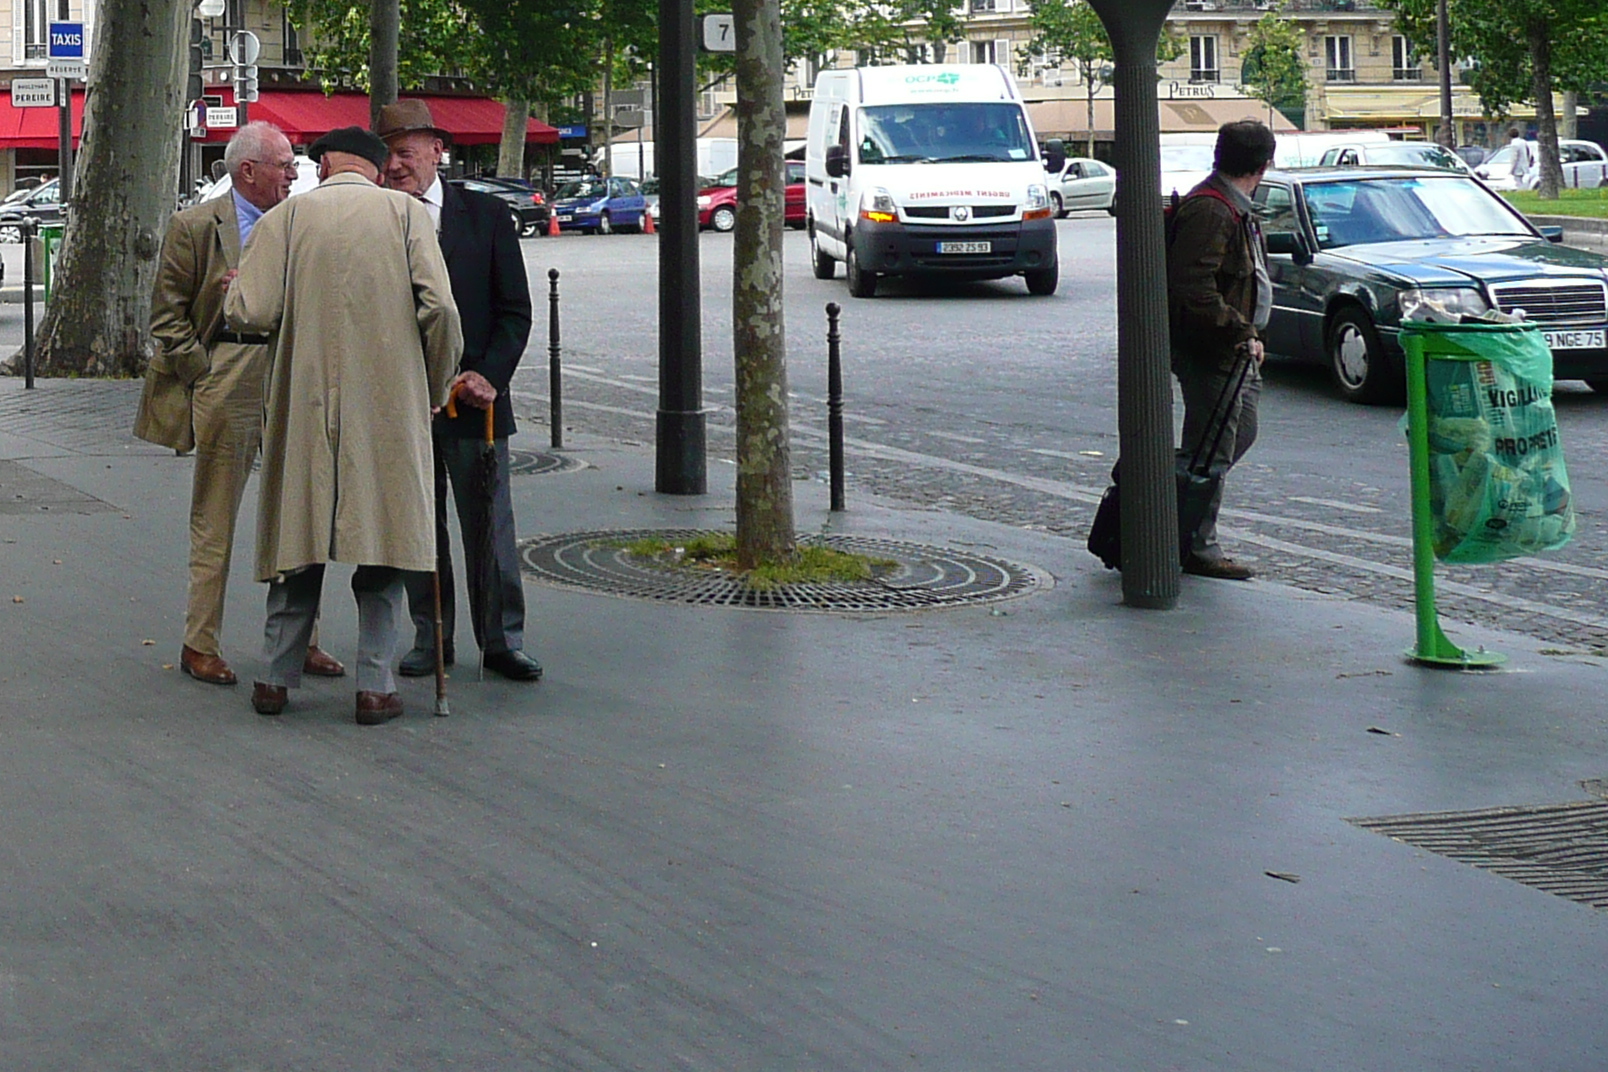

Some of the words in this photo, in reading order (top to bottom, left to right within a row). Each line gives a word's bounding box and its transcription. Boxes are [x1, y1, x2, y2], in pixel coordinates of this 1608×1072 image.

[51, 33, 82, 46] TAXIS
[718, 23, 730, 41] 7
[1169, 80, 1215, 99] PETRUS
[15, 93, 52, 102] PEREIRE
[1556, 332, 1583, 347] NGE
[1585, 332, 1602, 346] 75
